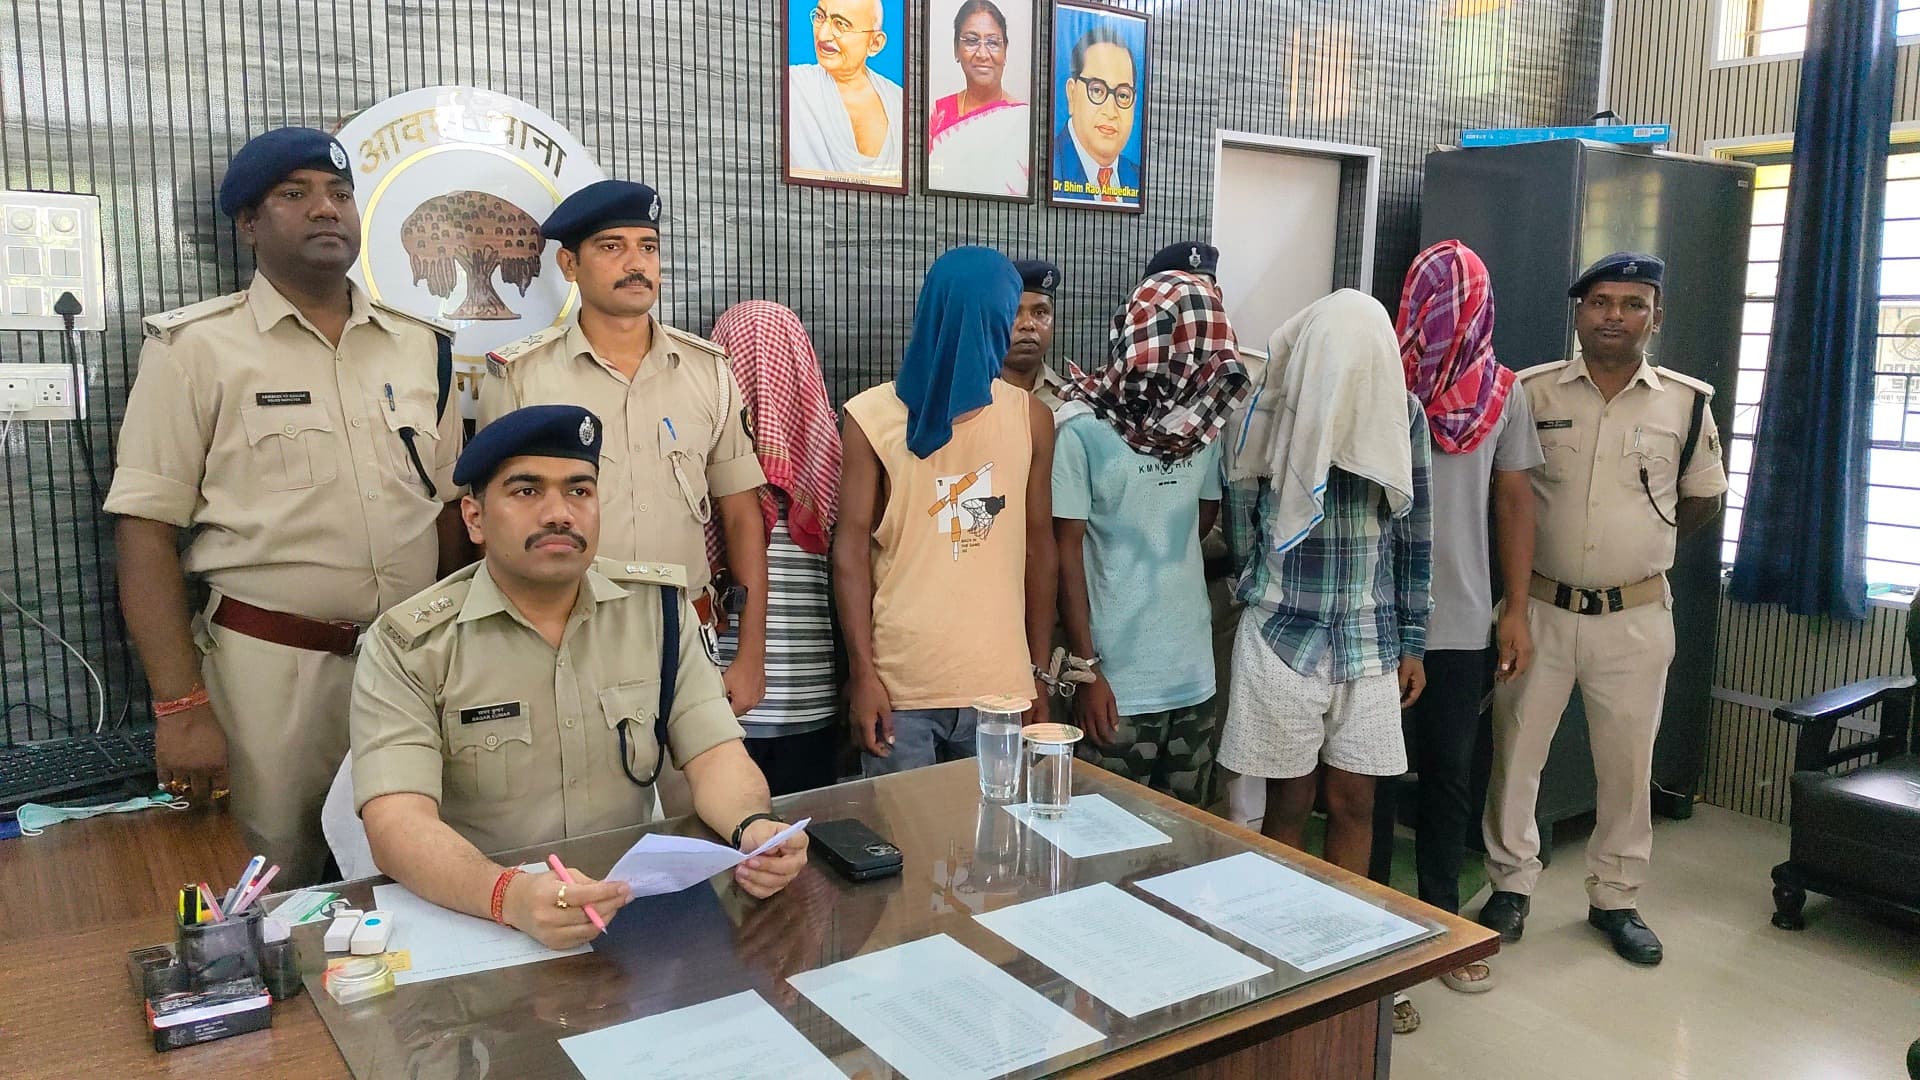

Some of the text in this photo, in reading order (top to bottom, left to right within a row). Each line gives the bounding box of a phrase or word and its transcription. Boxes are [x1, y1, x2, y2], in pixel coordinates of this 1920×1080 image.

[1053, 179, 1139, 198] Dr Bhim Rao Ambedkar
